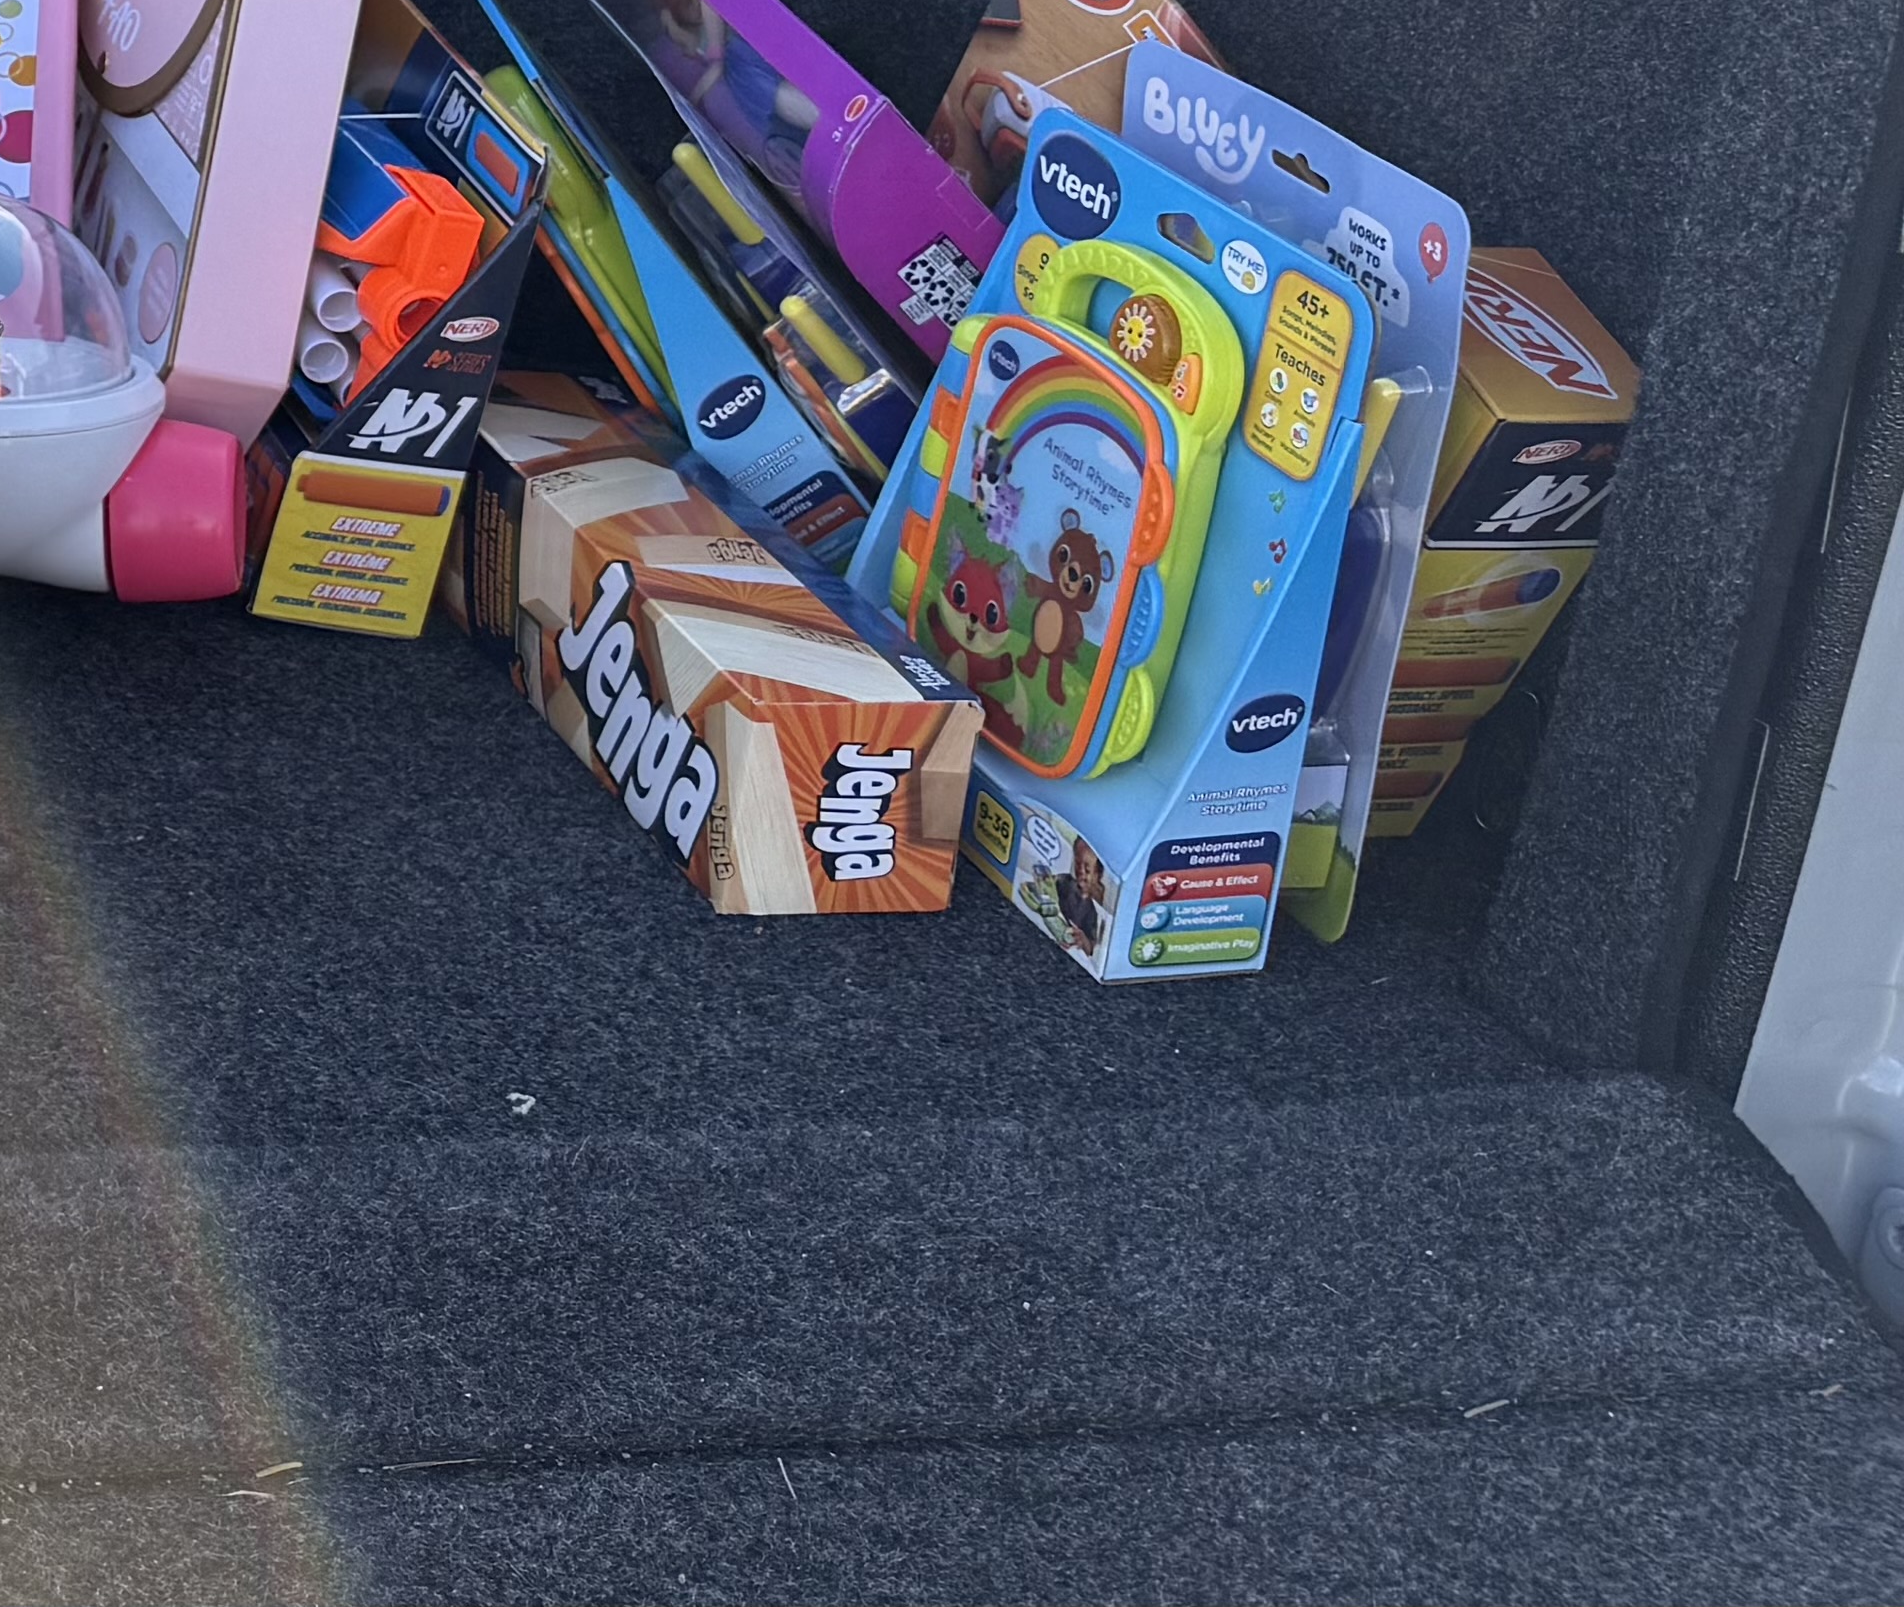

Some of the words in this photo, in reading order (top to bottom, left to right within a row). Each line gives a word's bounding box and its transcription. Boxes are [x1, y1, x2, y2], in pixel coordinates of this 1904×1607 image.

[1142, 76, 1266, 168] BLUEY
[1039, 154, 1112, 221] vtech
[1348, 217, 1388, 252] WORKS
[1227, 245, 1249, 267] TRY
[1349, 240, 1365, 258] UP
[1365, 250, 1381, 269] TO
[1296, 290, 1331, 320] 45+
[440, 318, 499, 340] NERF
[991, 351, 1018, 374] vtech
[1275, 343, 1327, 387] Teaches
[699, 383, 762, 429] vtech
[1043, 437, 1085, 475] Animal
[1085, 466, 1133, 509] Rhymes
[559, 562, 718, 860] Jenga
[1230, 707, 1300, 736] vtech
[1186, 788, 1235, 804] Animal
[1234, 782, 1289, 801] Rhymes
[811, 743, 914, 881] Jenga
[978, 802, 1011, 840] 9-36
[1200, 799, 1268, 817] Storytime
[1170, 837, 1266, 855] Developmental
[1188, 851, 1242, 866] Benefits
[1180, 877, 1214, 891] Cause
[1224, 874, 1259, 887] Effect
[1172, 912, 1246, 927] Development
[1174, 903, 1229, 918] Language
[1166, 939, 1232, 954] Imaginative
[1232, 938, 1256, 952] Play
